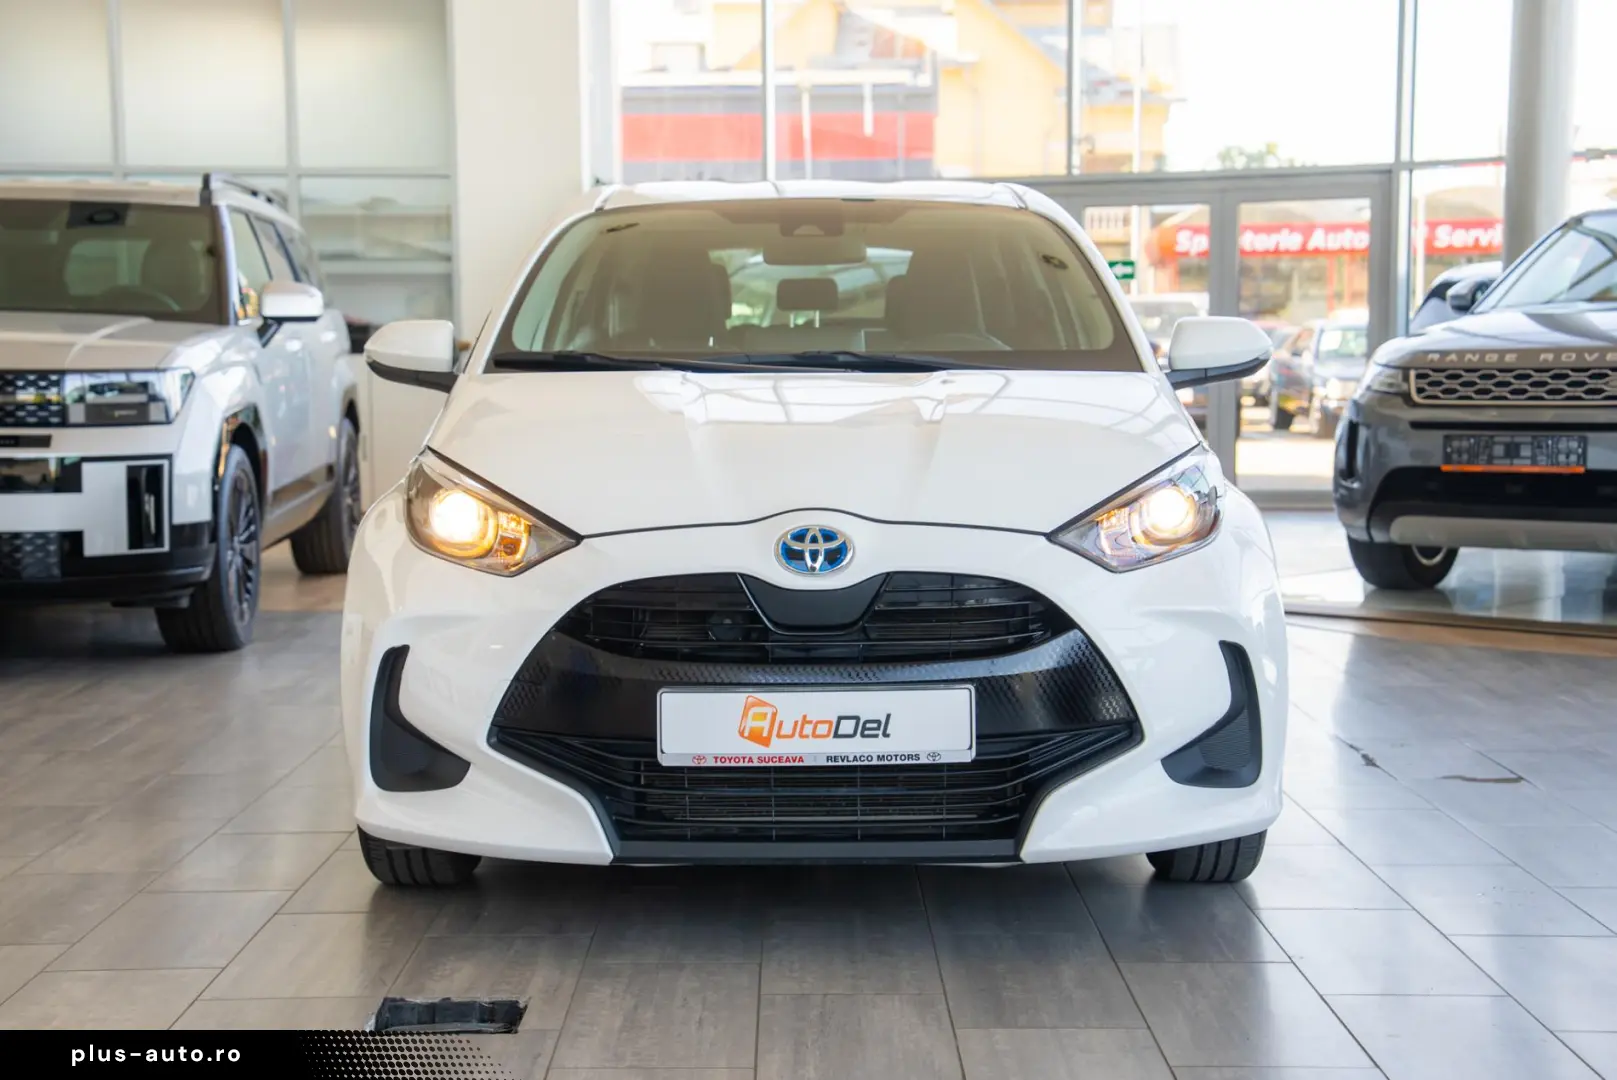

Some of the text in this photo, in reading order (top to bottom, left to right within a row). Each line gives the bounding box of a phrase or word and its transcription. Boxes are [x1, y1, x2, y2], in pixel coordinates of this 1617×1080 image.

[1306, 228, 1371, 251] Auto
[1433, 224, 1503, 249] Servi
[1427, 352, 1617, 363] RANGE ROVE
[742, 703, 891, 741] AutoDel
[713, 752, 921, 765] TOYOTA SUCEAVA REVLACO MOTORS
